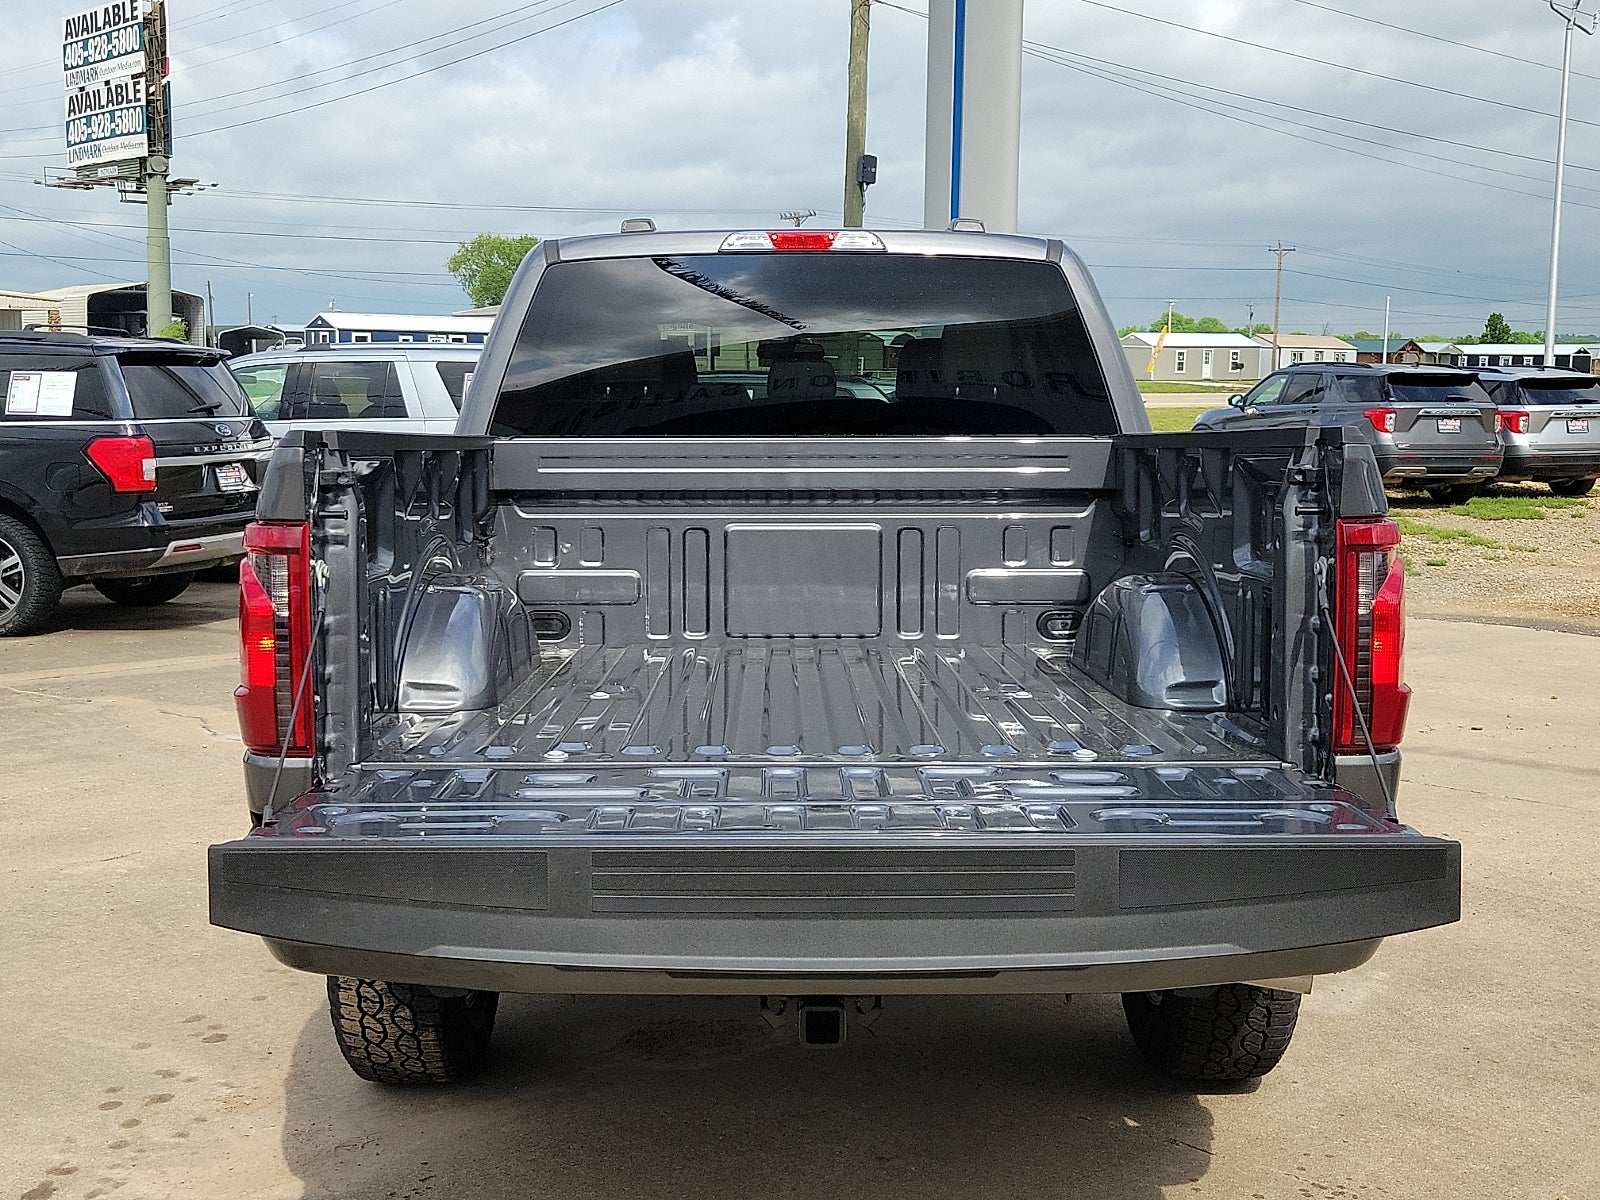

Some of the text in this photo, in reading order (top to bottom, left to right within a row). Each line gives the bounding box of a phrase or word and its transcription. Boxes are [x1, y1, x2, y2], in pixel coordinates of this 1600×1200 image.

[64, 0, 139, 41] AVAILABLE
[65, 24, 140, 68] 405-928-5800
[67, 80, 142, 118] AVAILABLE
[68, 106, 143, 145] 405-928-5800
